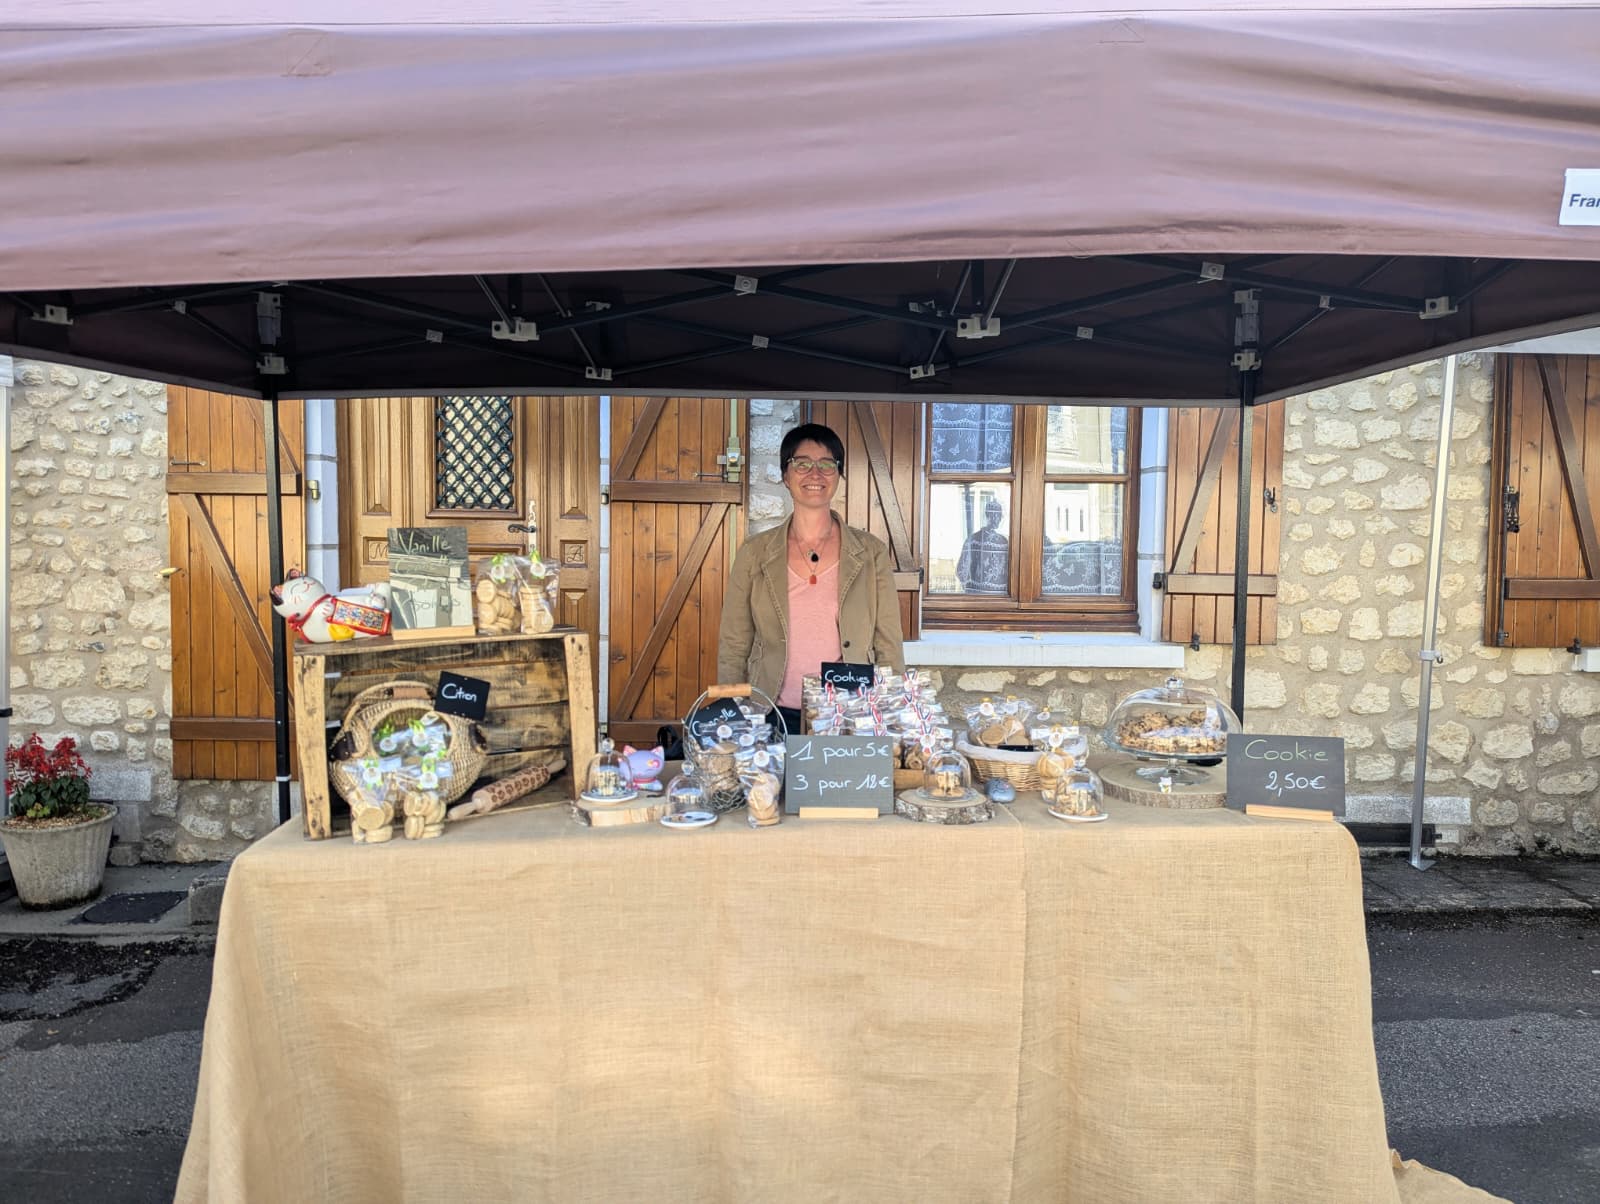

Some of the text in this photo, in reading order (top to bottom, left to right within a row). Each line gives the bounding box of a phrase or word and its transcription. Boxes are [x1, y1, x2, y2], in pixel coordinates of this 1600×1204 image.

[398, 530, 452, 556] Vanille
[824, 669, 871, 685] Cookies
[441, 682, 477, 703] Citron
[790, 740, 889, 765] 1 pour 5€
[1245, 739, 1328, 761] Cookie
[792, 773, 809, 791] 3
[818, 778, 852, 797] pour
[1265, 770, 1326, 797] 2,50€
